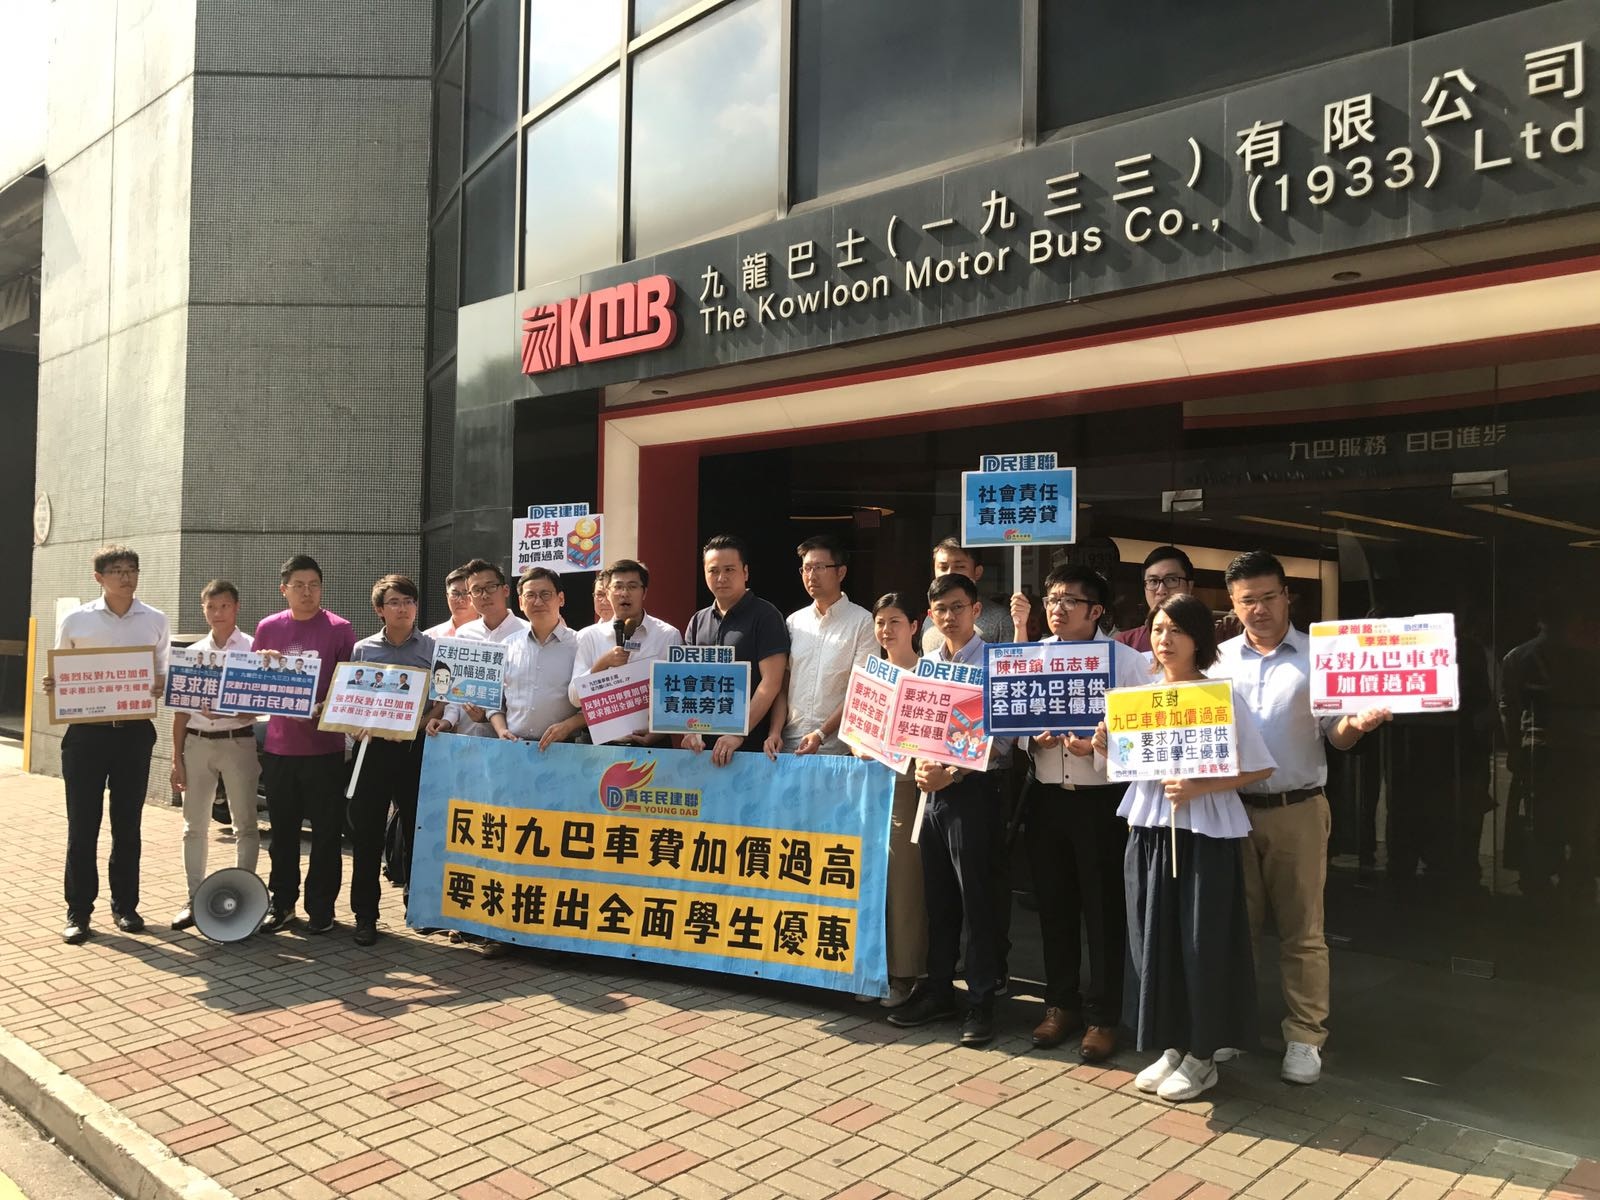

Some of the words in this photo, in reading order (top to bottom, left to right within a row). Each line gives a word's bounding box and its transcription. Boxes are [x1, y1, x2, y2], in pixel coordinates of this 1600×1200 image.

[700, 307, 745, 335] The
[758, 273, 889, 321] Kowloon
[905, 246, 1010, 291] Motor
[1029, 226, 1102, 264] Bus
[1124, 206, 1220, 243] Co.,
[1249, 135, 1441, 223] (1933)
[1474, 107, 1584, 171] Ltd
[560, 275, 677, 366] KMB
[1289, 435, 1387, 460] 九巴服務
[1406, 425, 1507, 453] 日日進步
[978, 482, 1058, 503] 社會責任
[978, 505, 1057, 525] 責無旁貸
[525, 521, 559, 538] 反對
[519, 537, 564, 551] 九巴車費
[519, 550, 564, 563] 加價過高
[436, 645, 504, 665] 反對巴士車費
[1050, 656, 1100, 672] 伍志華
[1315, 648, 1450, 671] 反對九巴車費
[60, 669, 149, 682] 強烈反對九巴加價
[171, 674, 218, 696] 要求推
[664, 674, 735, 692] 社會責任
[1336, 673, 1427, 693] 加價過高
[60, 683, 150, 696] 要求推出全面學生優惠
[584, 683, 650, 710] 反對九巴車費加價
[855, 681, 887, 707] 要求九巴
[904, 687, 951, 707] 要求九巴
[992, 678, 1106, 699] 要求九巴提供
[223, 692, 310, 712] 加重市民負擔
[335, 694, 415, 711] 強烈反對九巴加價
[664, 696, 734, 714] 責無旁貸
[992, 697, 1106, 716] 全面學生優惠
[1151, 690, 1179, 709] 反對
[332, 705, 413, 721] 要求推出全面學生優惠
[851, 697, 884, 723] 提供全面
[900, 703, 948, 724] 提供全面
[1112, 705, 1229, 731] 九巴車費加價過高
[848, 712, 881, 738] 學生優惠
[898, 721, 945, 741] 學生優惠
[1141, 726, 1229, 748] 要求九巴提供
[1141, 743, 1230, 763] 全面學生優惠
[625, 788, 699, 808] 青年民建聯
[644, 806, 677, 815] YOUNG
[679, 809, 698, 817] DAB
[450, 808, 856, 890] 反對九巴車費加價過高
[446, 871, 852, 962] 要求推出全面學生優惠
